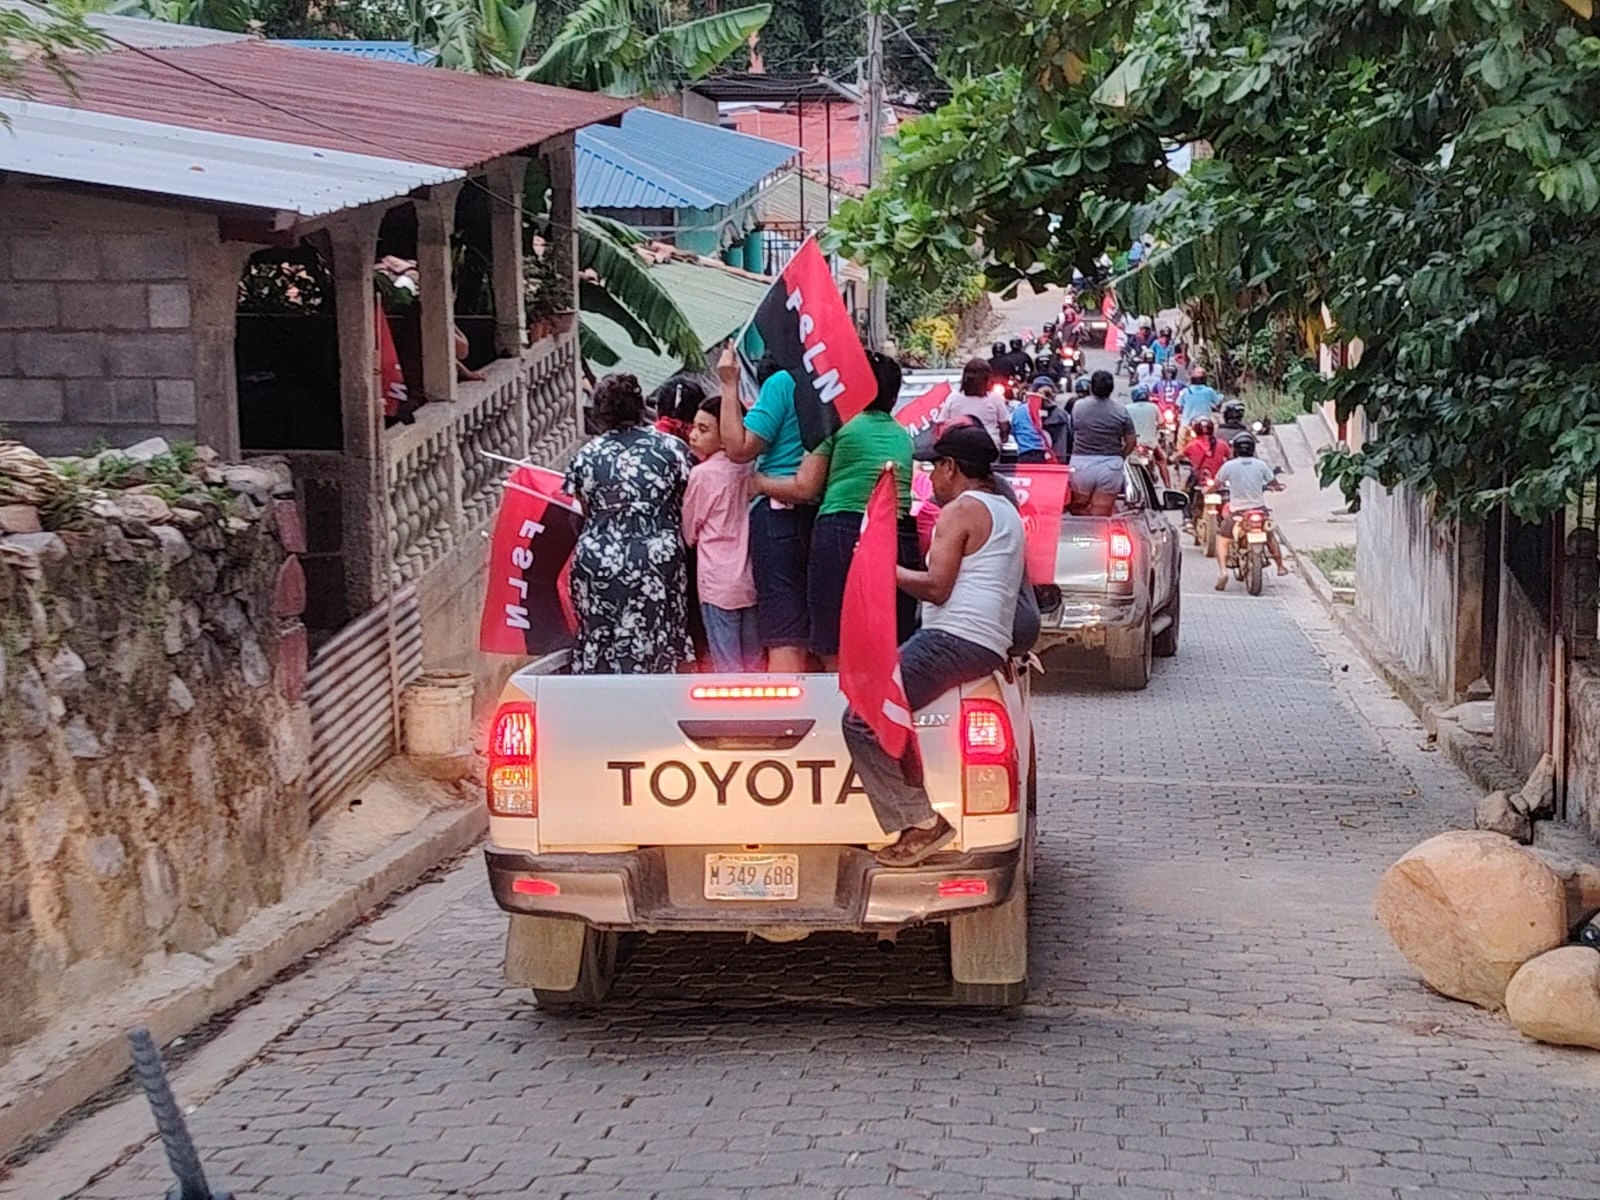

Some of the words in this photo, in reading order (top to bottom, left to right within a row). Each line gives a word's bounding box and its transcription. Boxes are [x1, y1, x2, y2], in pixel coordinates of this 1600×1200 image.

[607, 760, 867, 807] TOYOTA
[725, 865, 757, 886] 349
[763, 865, 794, 886] 688
